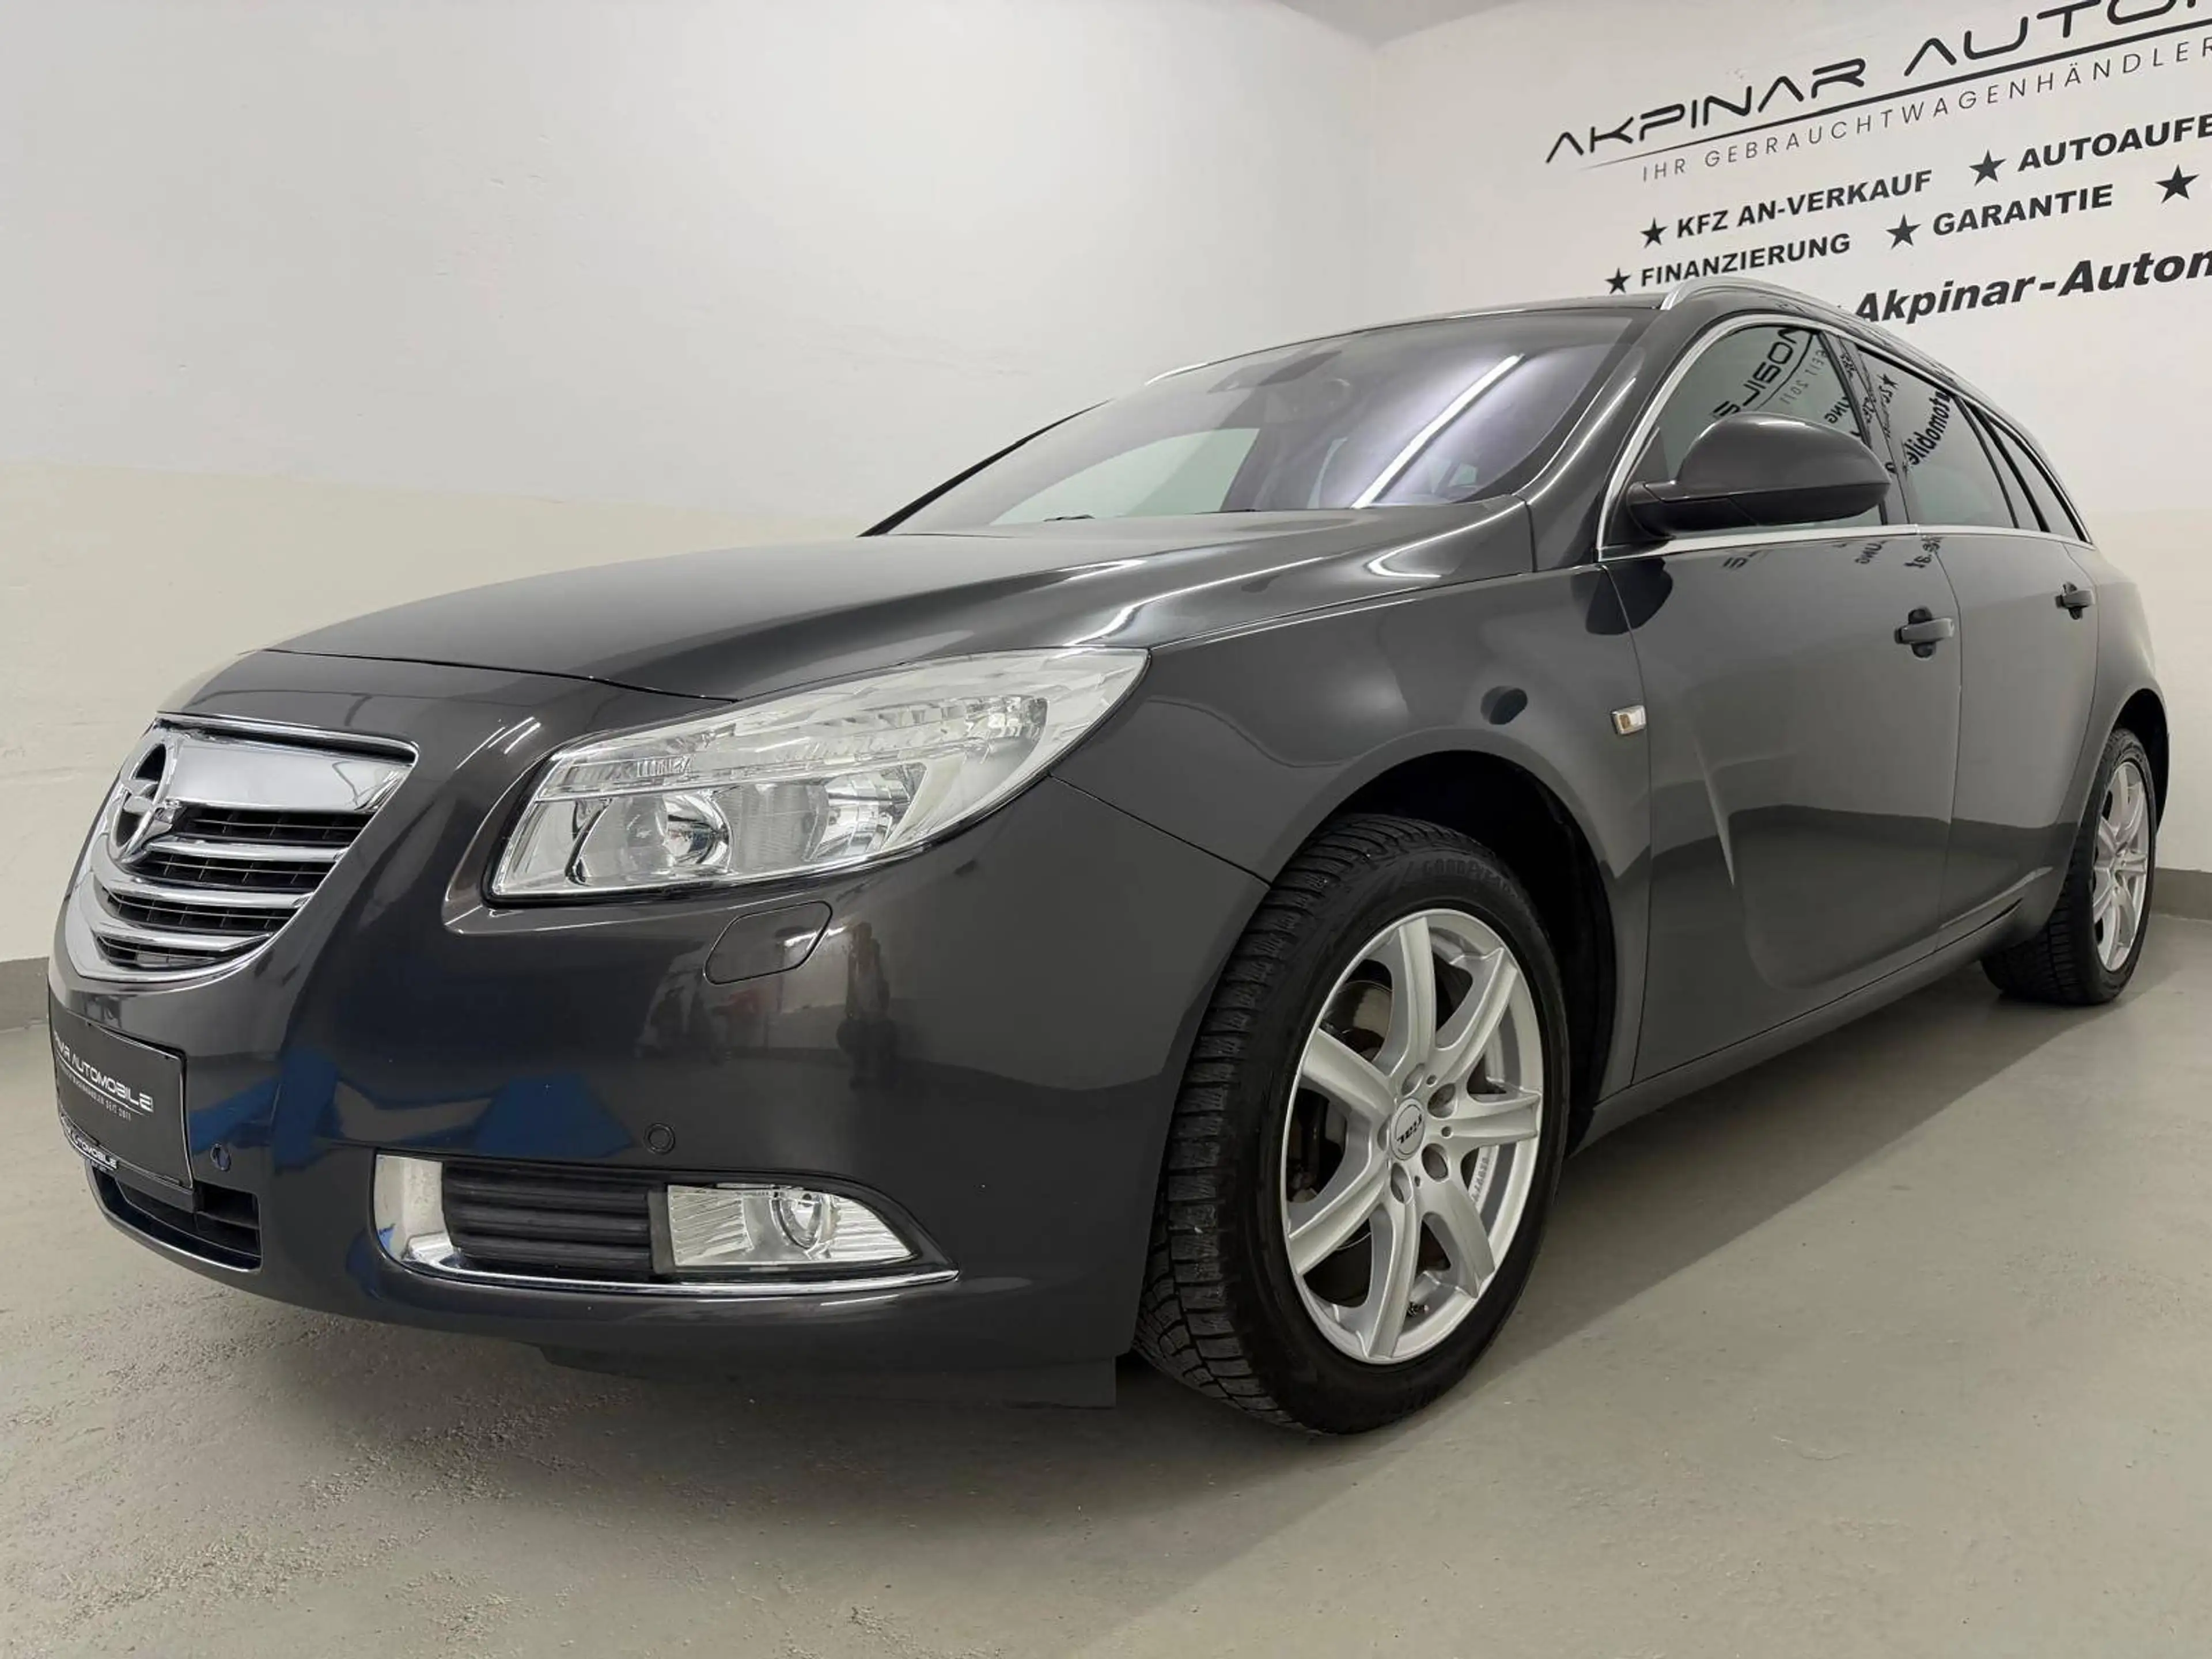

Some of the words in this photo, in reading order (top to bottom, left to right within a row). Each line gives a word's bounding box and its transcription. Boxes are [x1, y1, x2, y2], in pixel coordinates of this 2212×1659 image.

[1545, 58, 1866, 164] AKPINAR
[1904, 0, 2196, 77] AUTO
[1643, 158, 1685, 182] IHR
[1677, 210, 1729, 238] KFZ
[1736, 169, 1932, 228] AN-VERKAUF
[2017, 113, 2212, 172] AUTOAUFE
[1641, 233, 1851, 287] FINANZIERUNG
[1933, 184, 2113, 236] GARANTIE
